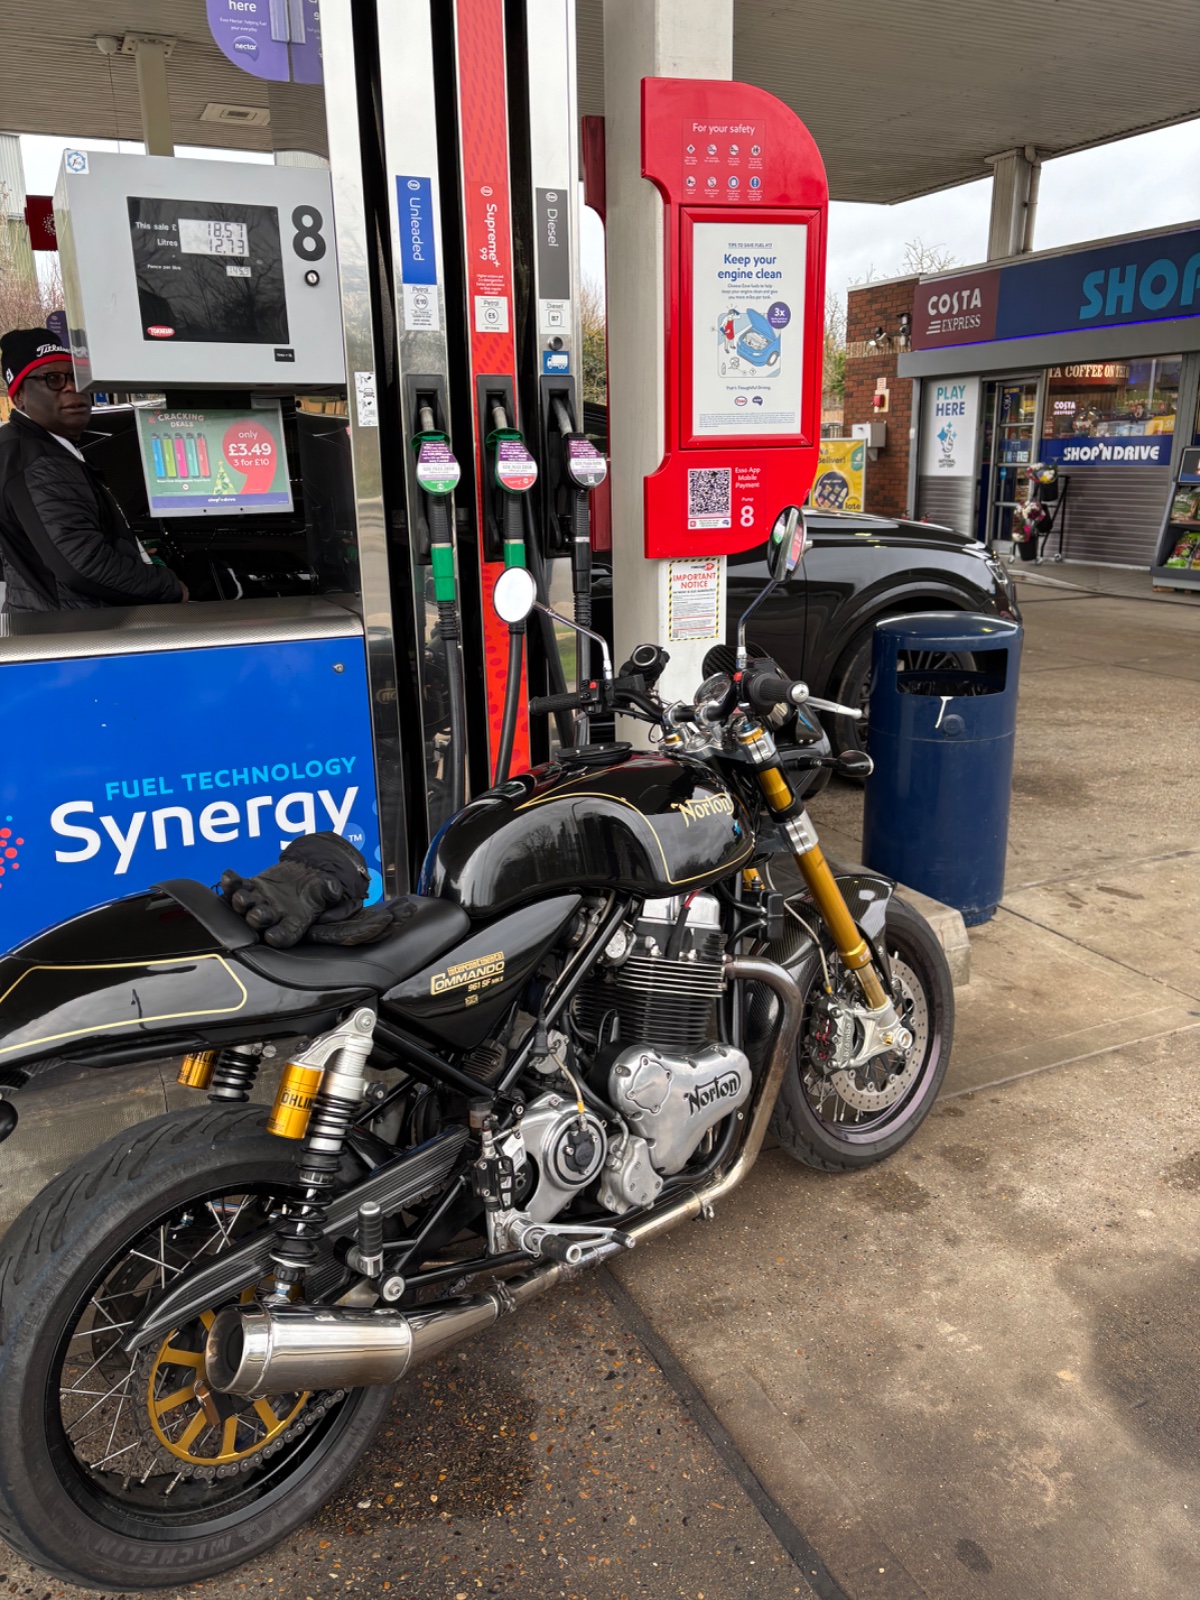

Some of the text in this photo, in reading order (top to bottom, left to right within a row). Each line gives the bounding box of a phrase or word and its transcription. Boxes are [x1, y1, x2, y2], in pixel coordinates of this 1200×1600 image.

[228, 0, 257, 12] here
[234, 43, 257, 51] nectar
[692, 123, 755, 136] For your safety
[135, 221, 151, 230] This
[154, 223, 169, 231] sale
[171, 223, 177, 231] £
[291, 204, 326, 262] 8
[409, 197, 425, 261] Unleaded
[547, 208, 559, 247] Diesel
[157, 238, 178, 247] Litres
[479, 247, 488, 261] 99
[724, 253, 777, 267] Keep your
[717, 267, 782, 282] engine clean
[927, 287, 982, 316] COSTA
[774, 307, 785, 317] 3x
[941, 314, 981, 334] EXPRESS
[1065, 364, 1103, 378] COFFEE
[1104, 364, 1115, 377] ON
[937, 385, 966, 400] PLAY
[936, 402, 965, 416] HERE
[1054, 401, 1076, 410] COSTA
[158, 412, 205, 422] CRACKING
[238, 430, 258, 439] only
[228, 443, 272, 456] £3.49
[241, 458, 253, 466] for
[254, 458, 270, 466] £10
[845, 502, 861, 510] late
[740, 505, 754, 527] 8
[673, 572, 716, 581] IMPORTANT
[681, 581, 708, 589] NOTICE
[105, 756, 357, 801] FUEL TECHNOLOGY
[670, 793, 734, 827] Norton
[50, 785, 359, 875] Synergy
[430, 961, 505, 995] COMMANDO
[843, 1022, 851, 1057] brembo
[684, 1070, 741, 1115] Norton
